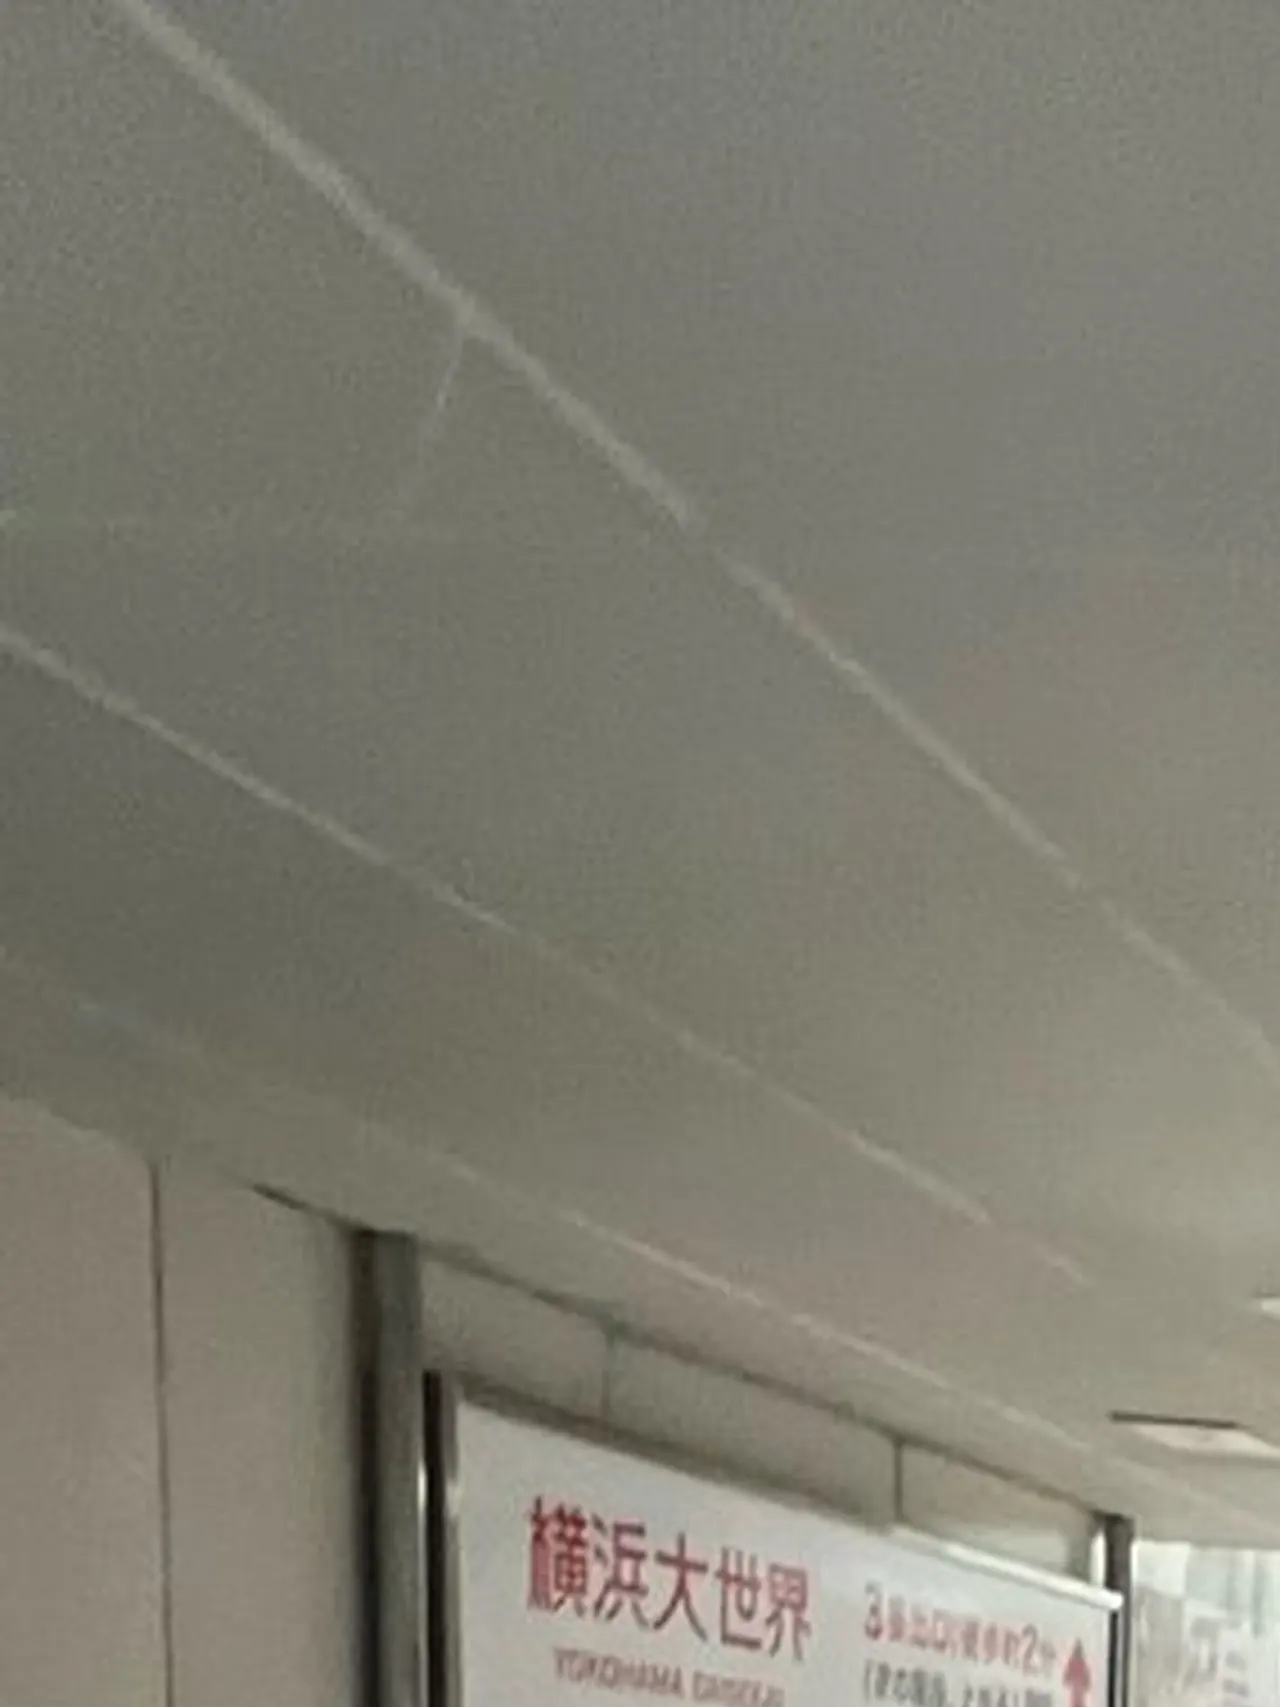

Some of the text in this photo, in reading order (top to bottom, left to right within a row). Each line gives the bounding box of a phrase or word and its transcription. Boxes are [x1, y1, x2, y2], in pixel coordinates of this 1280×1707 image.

[530, 1496, 813, 1662] 横浜大世界
